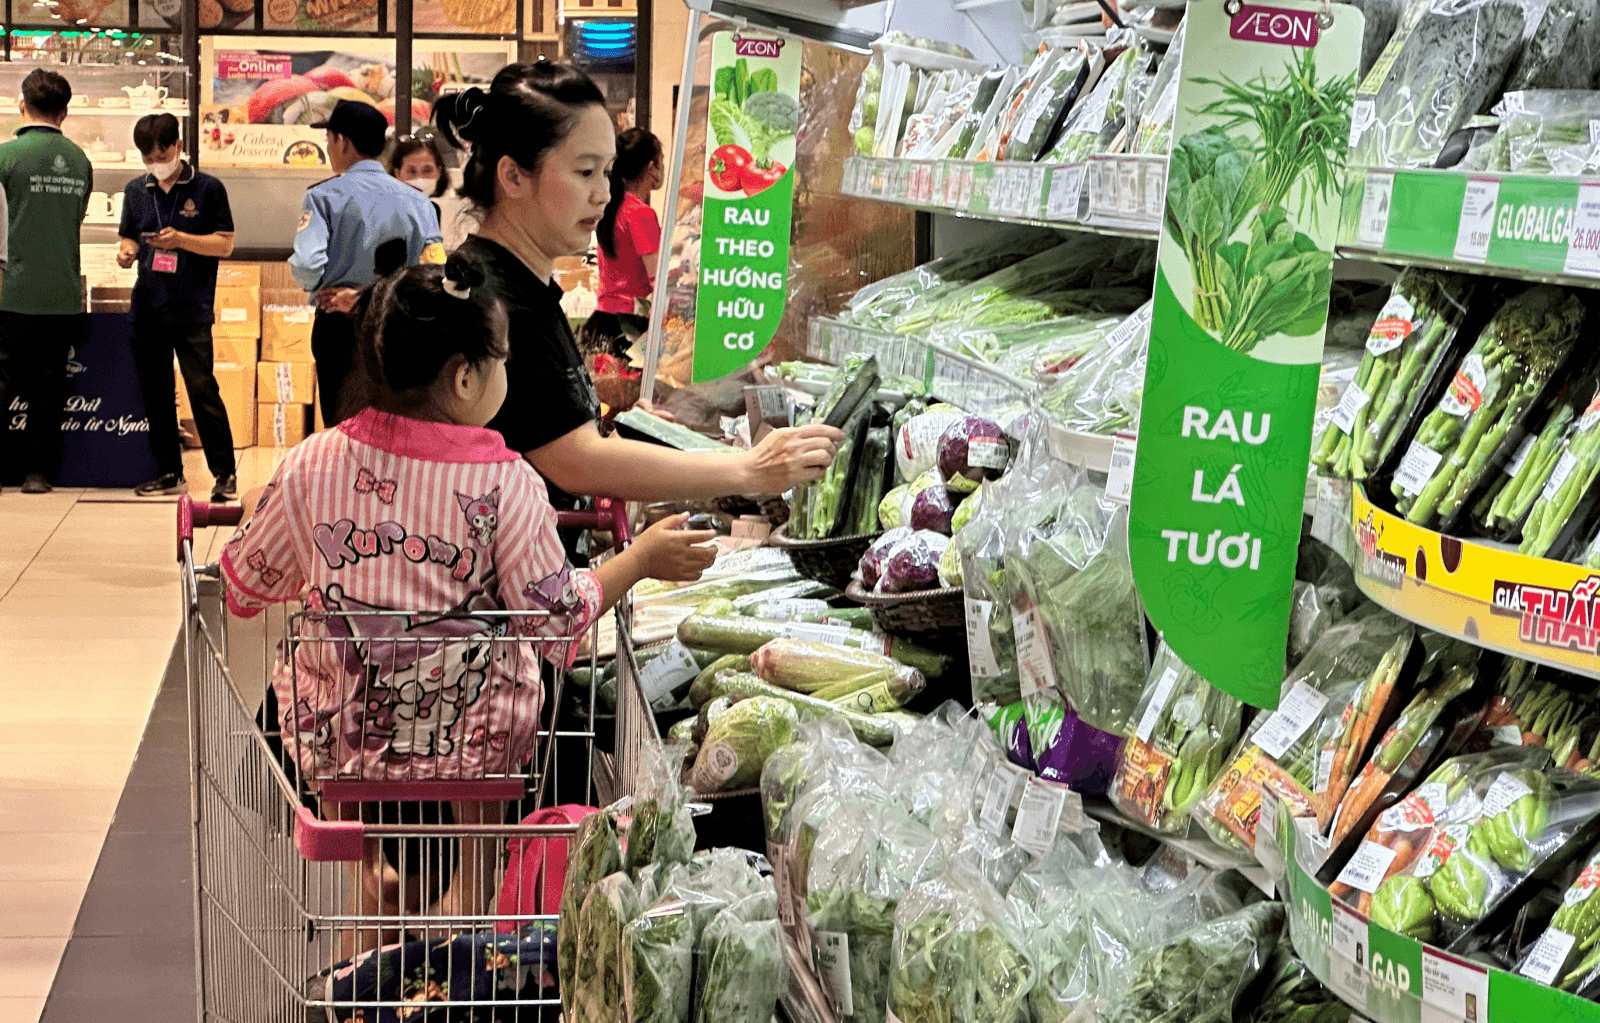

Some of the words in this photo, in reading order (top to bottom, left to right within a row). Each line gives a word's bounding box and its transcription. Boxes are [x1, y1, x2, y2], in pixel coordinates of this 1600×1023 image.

[231, 143, 279, 157] Desserts
[242, 131, 276, 145] Cakes
[724, 206, 770, 227] RAU
[715, 237, 775, 258] THEO
[703, 265, 783, 291] HƯỚNG
[717, 297, 765, 321] HỮU
[723, 331, 755, 351] CƠ
[1181, 405, 1271, 446] RAU
[1191, 464, 1246, 507] LÁ
[312, 518, 476, 582] Kuromi
[1161, 529, 1262, 571] TƯƠI
[1495, 583, 1521, 611] GIÁ
